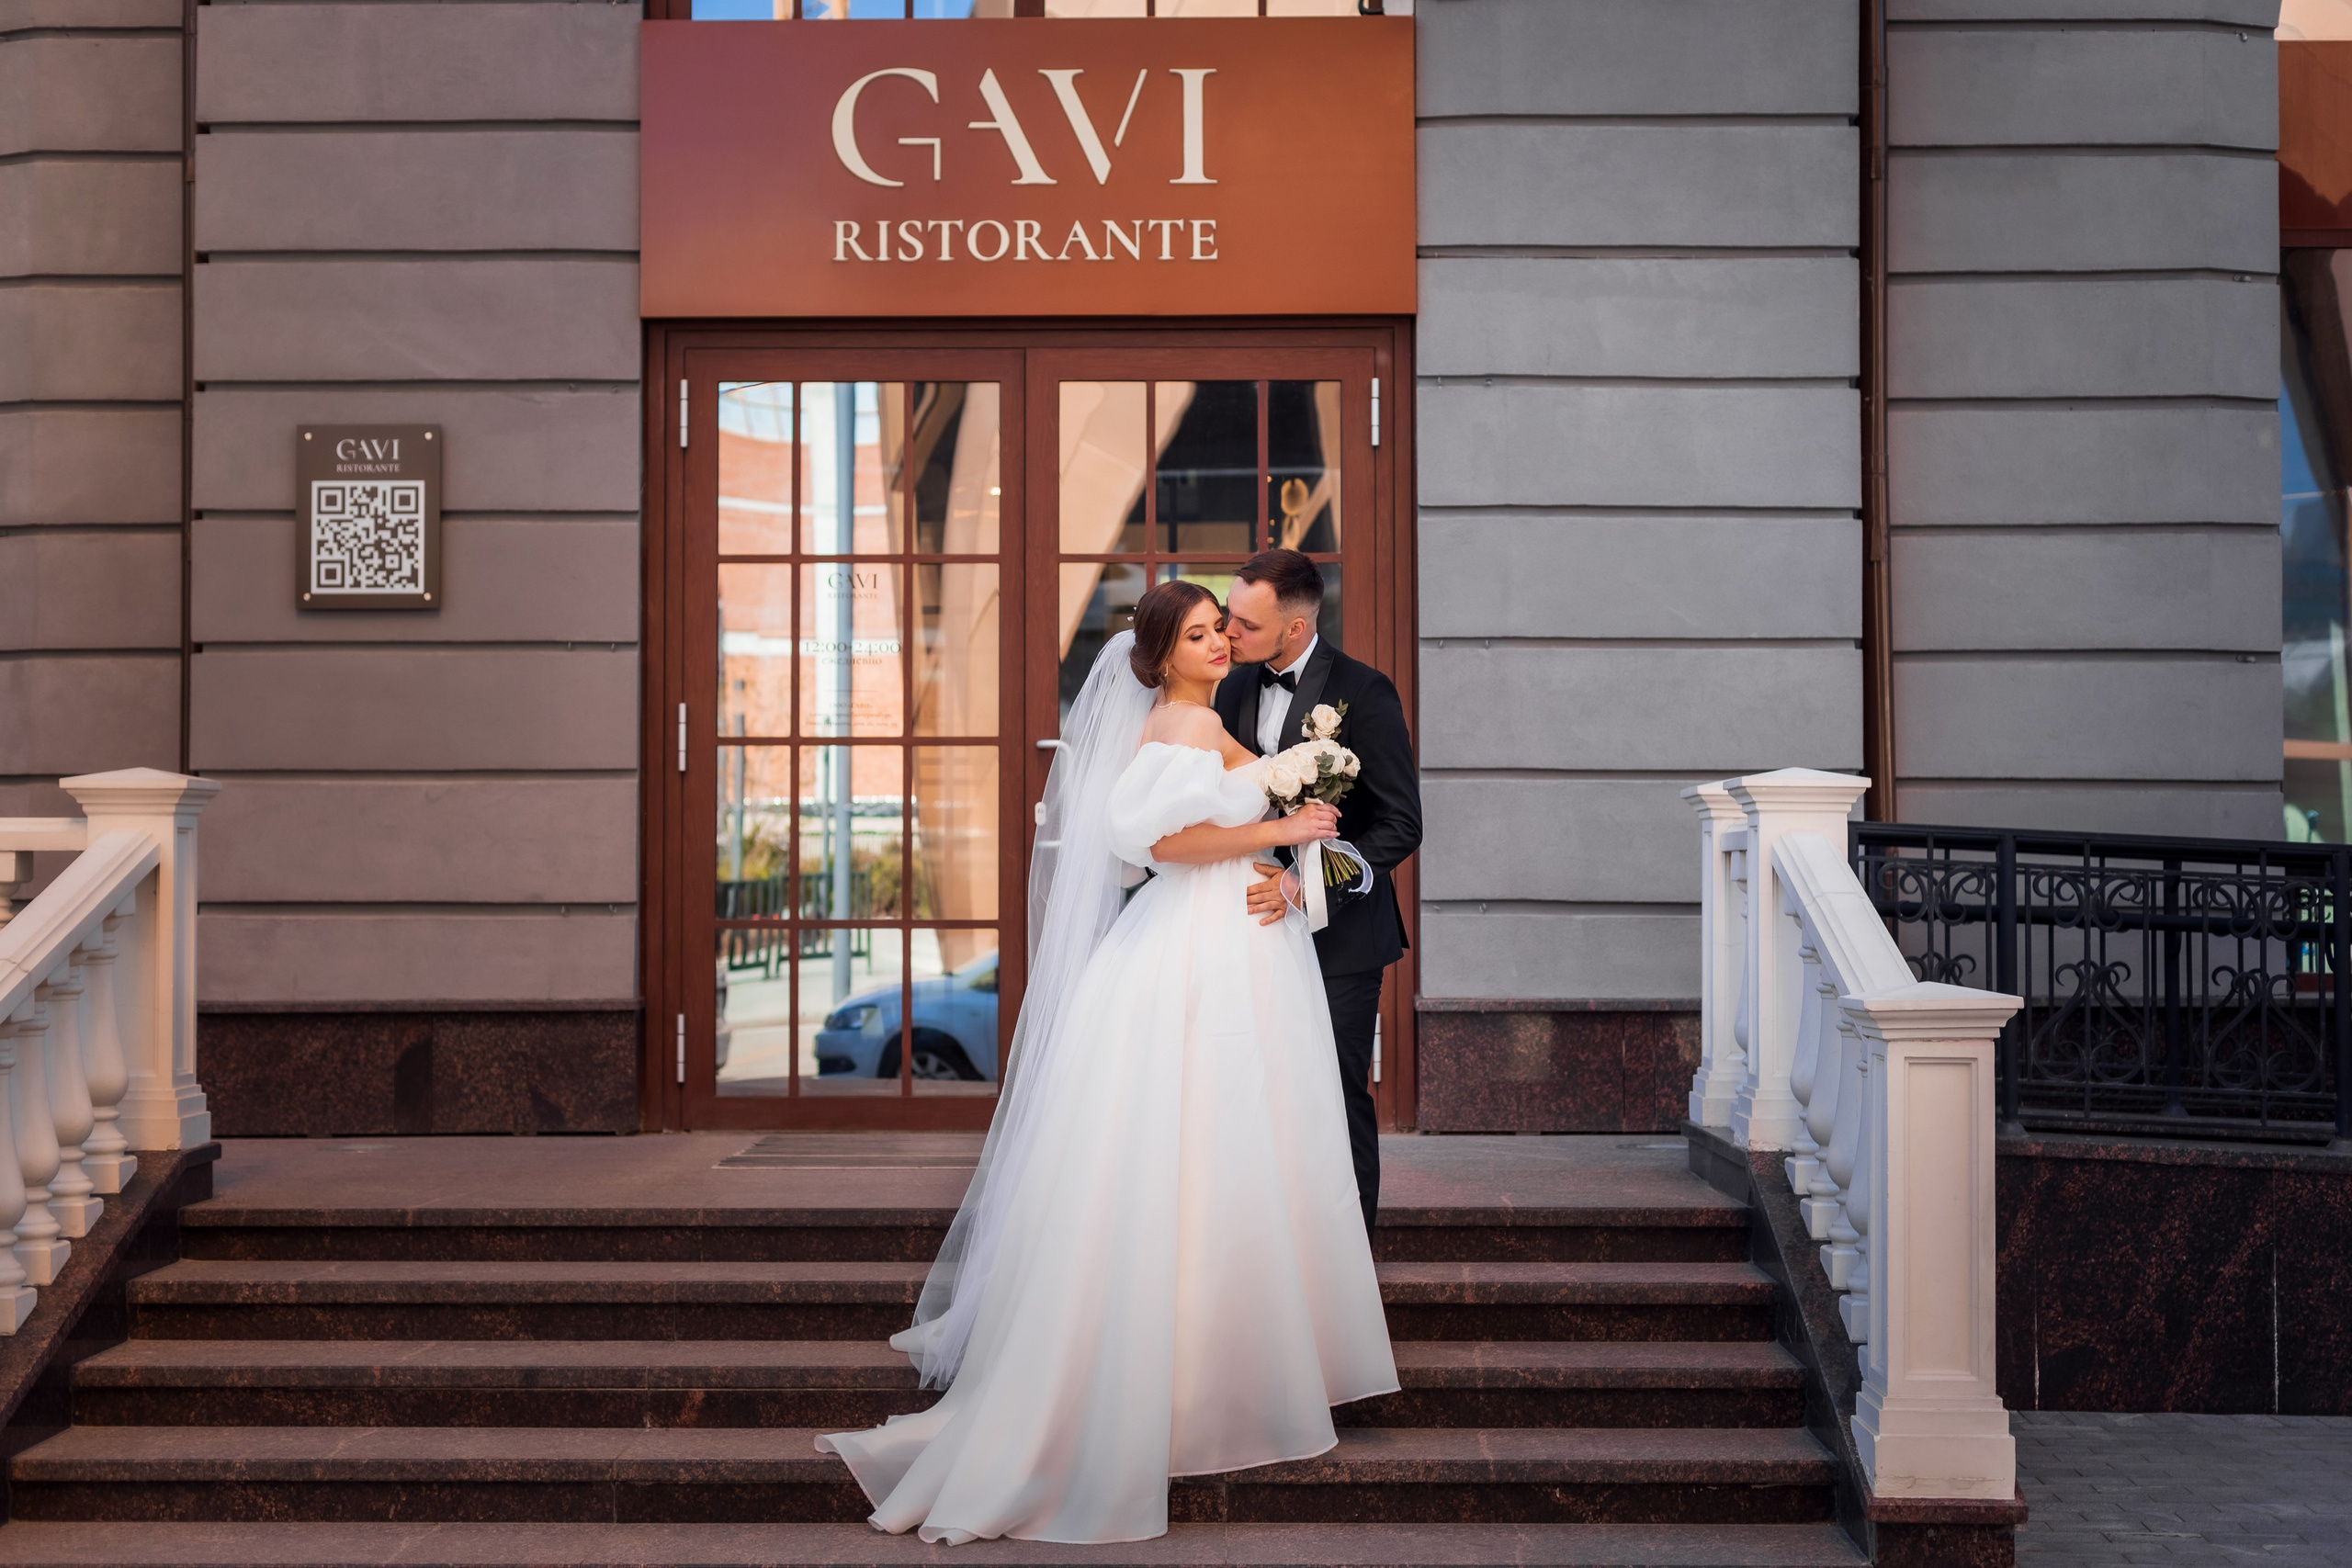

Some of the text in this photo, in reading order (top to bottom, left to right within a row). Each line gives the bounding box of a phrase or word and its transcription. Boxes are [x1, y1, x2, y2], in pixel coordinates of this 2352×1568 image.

[831, 67, 1218, 187] GAVI
[831, 219, 1218, 262] RISTORANTE
[335, 438, 401, 461] GAVI
[335, 463, 401, 473] RISTORANTE
[828, 572, 878, 589] GAVI
